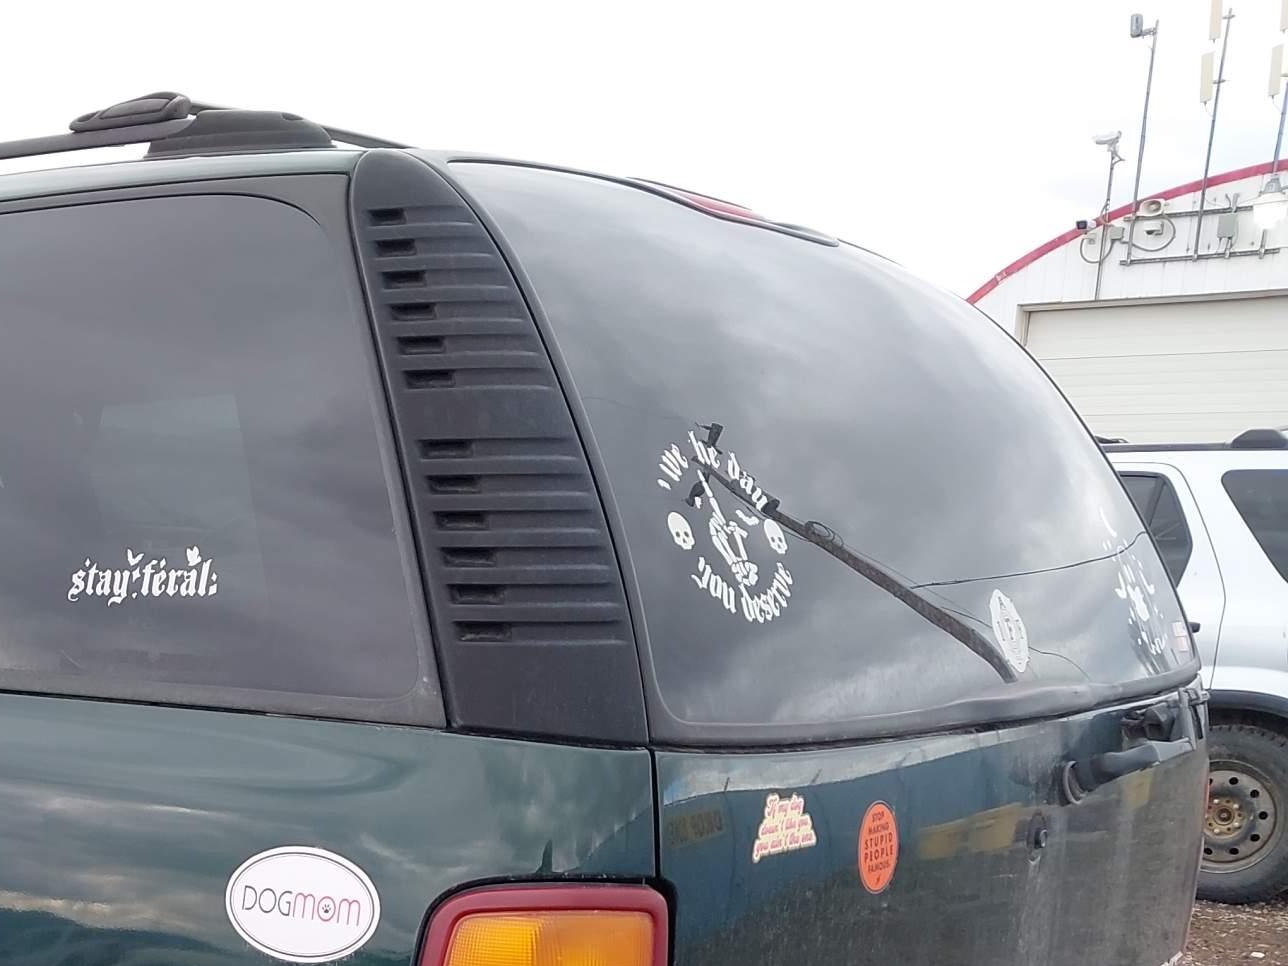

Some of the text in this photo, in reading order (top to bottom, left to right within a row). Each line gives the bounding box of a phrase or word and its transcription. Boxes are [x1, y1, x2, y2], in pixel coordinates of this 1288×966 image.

[67, 562, 130, 607] stay
[738, 562, 793, 623] deserve
[864, 832, 893, 850] STUPID
[864, 844, 894, 863] PEOPLE
